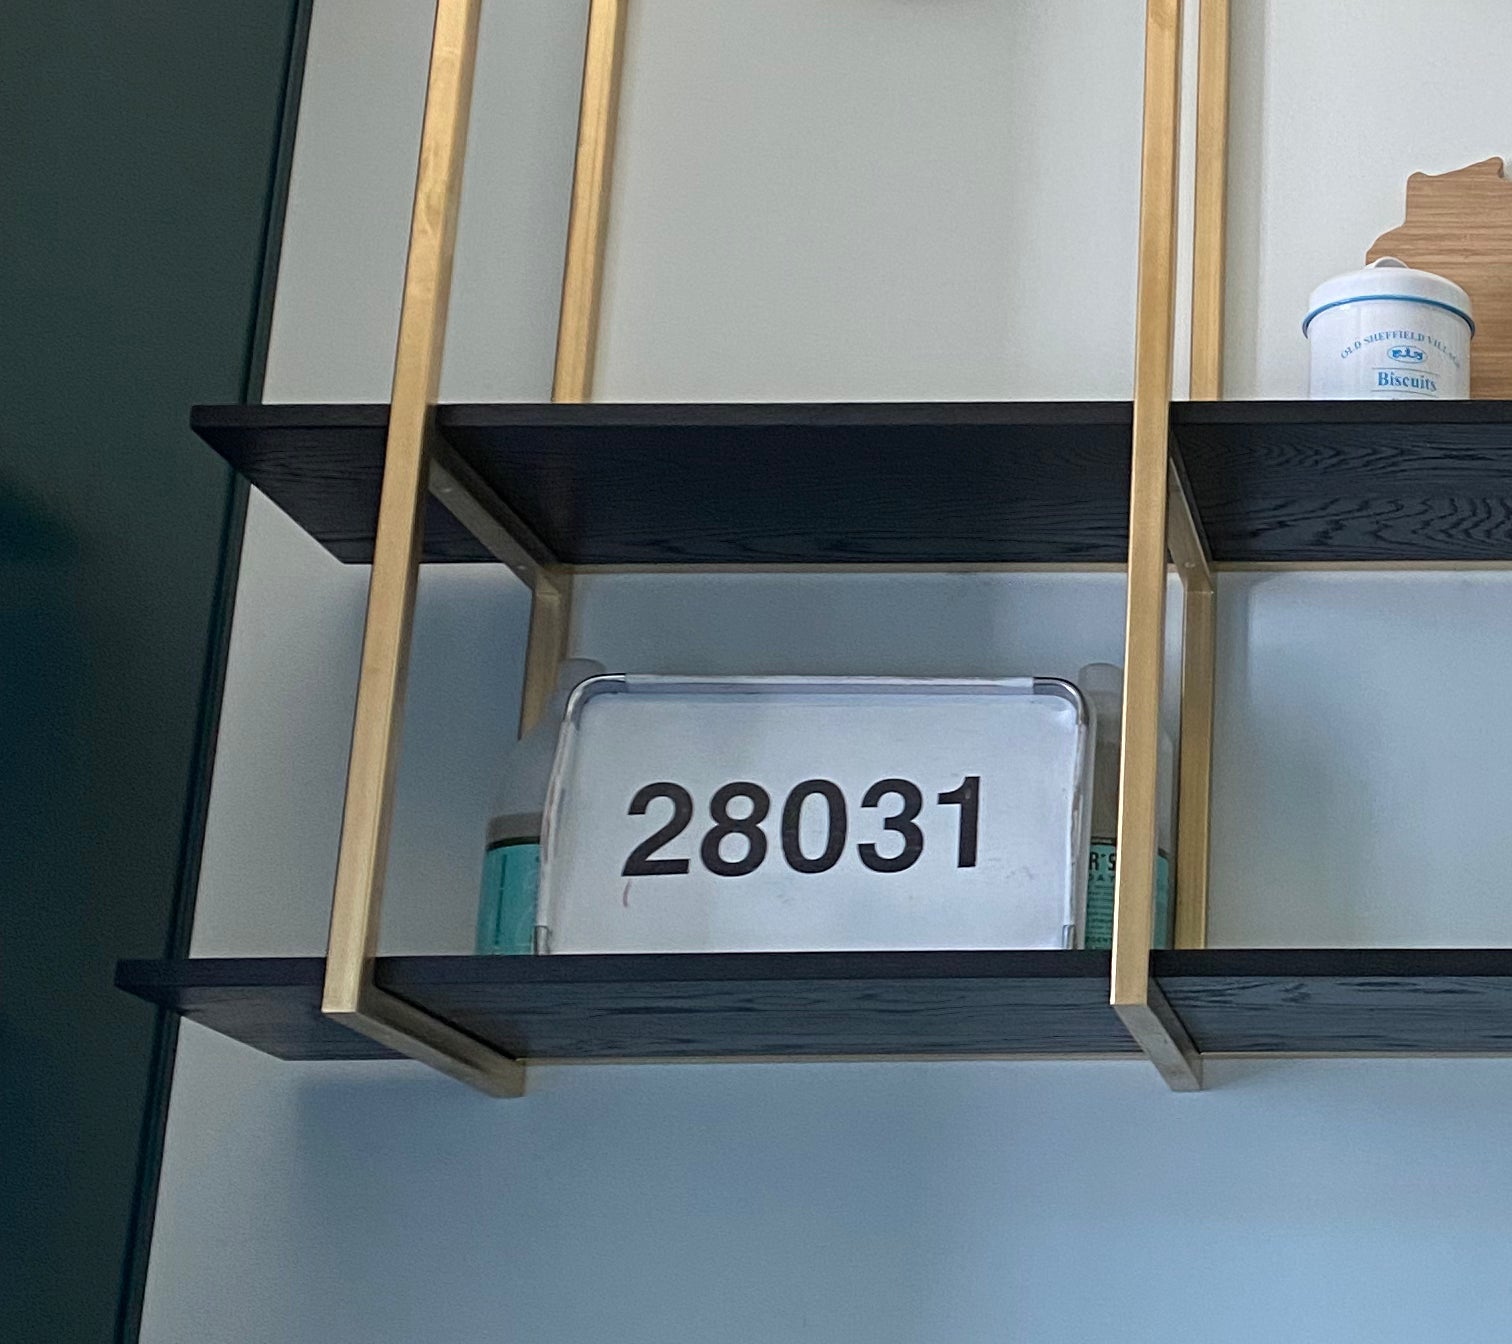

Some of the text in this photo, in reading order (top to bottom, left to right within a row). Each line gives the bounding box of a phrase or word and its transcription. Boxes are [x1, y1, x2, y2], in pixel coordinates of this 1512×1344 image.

[1363, 330, 1425, 344] SHEFFIELD
[1377, 371, 1437, 392] Biscuits
[620, 774, 982, 878] 28031
